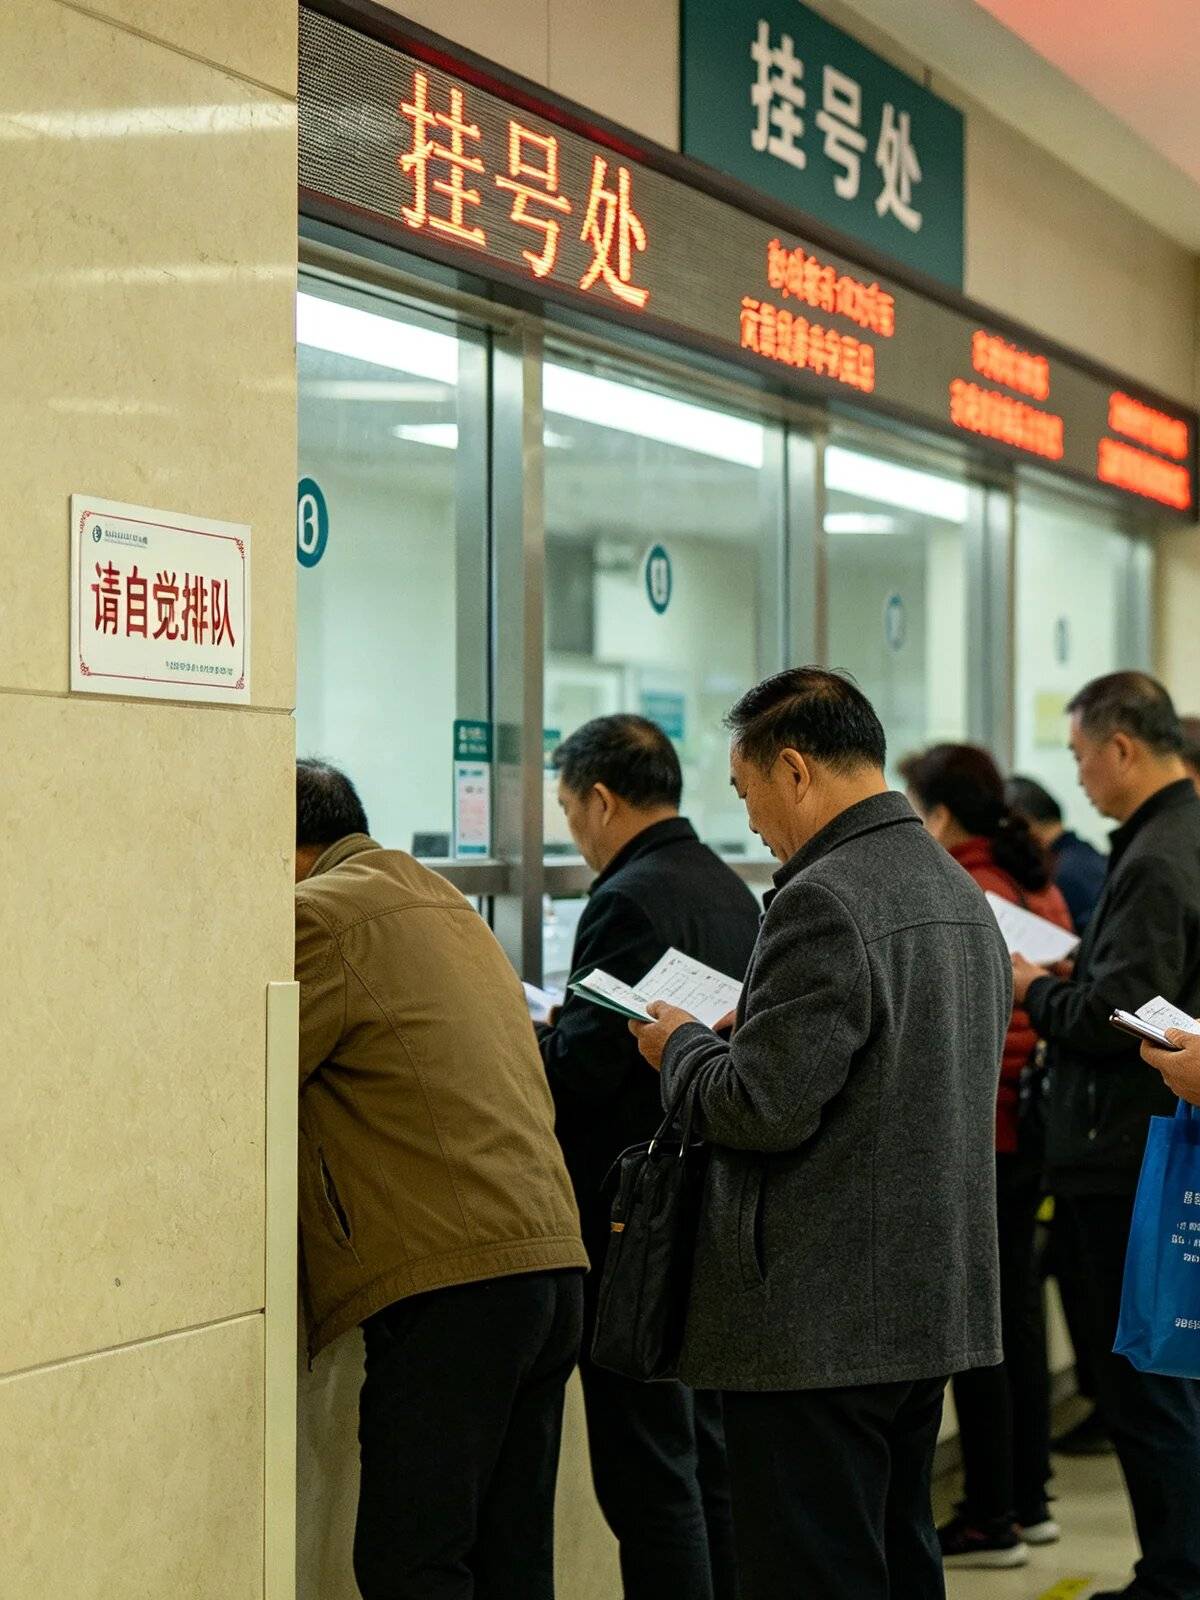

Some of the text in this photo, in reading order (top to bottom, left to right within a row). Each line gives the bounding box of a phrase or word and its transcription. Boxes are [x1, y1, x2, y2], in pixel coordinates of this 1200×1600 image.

[400, 71, 650, 309] 挂号处
[751, 18, 923, 233] 挂号处
[90, 560, 236, 647] 请自觉排队
